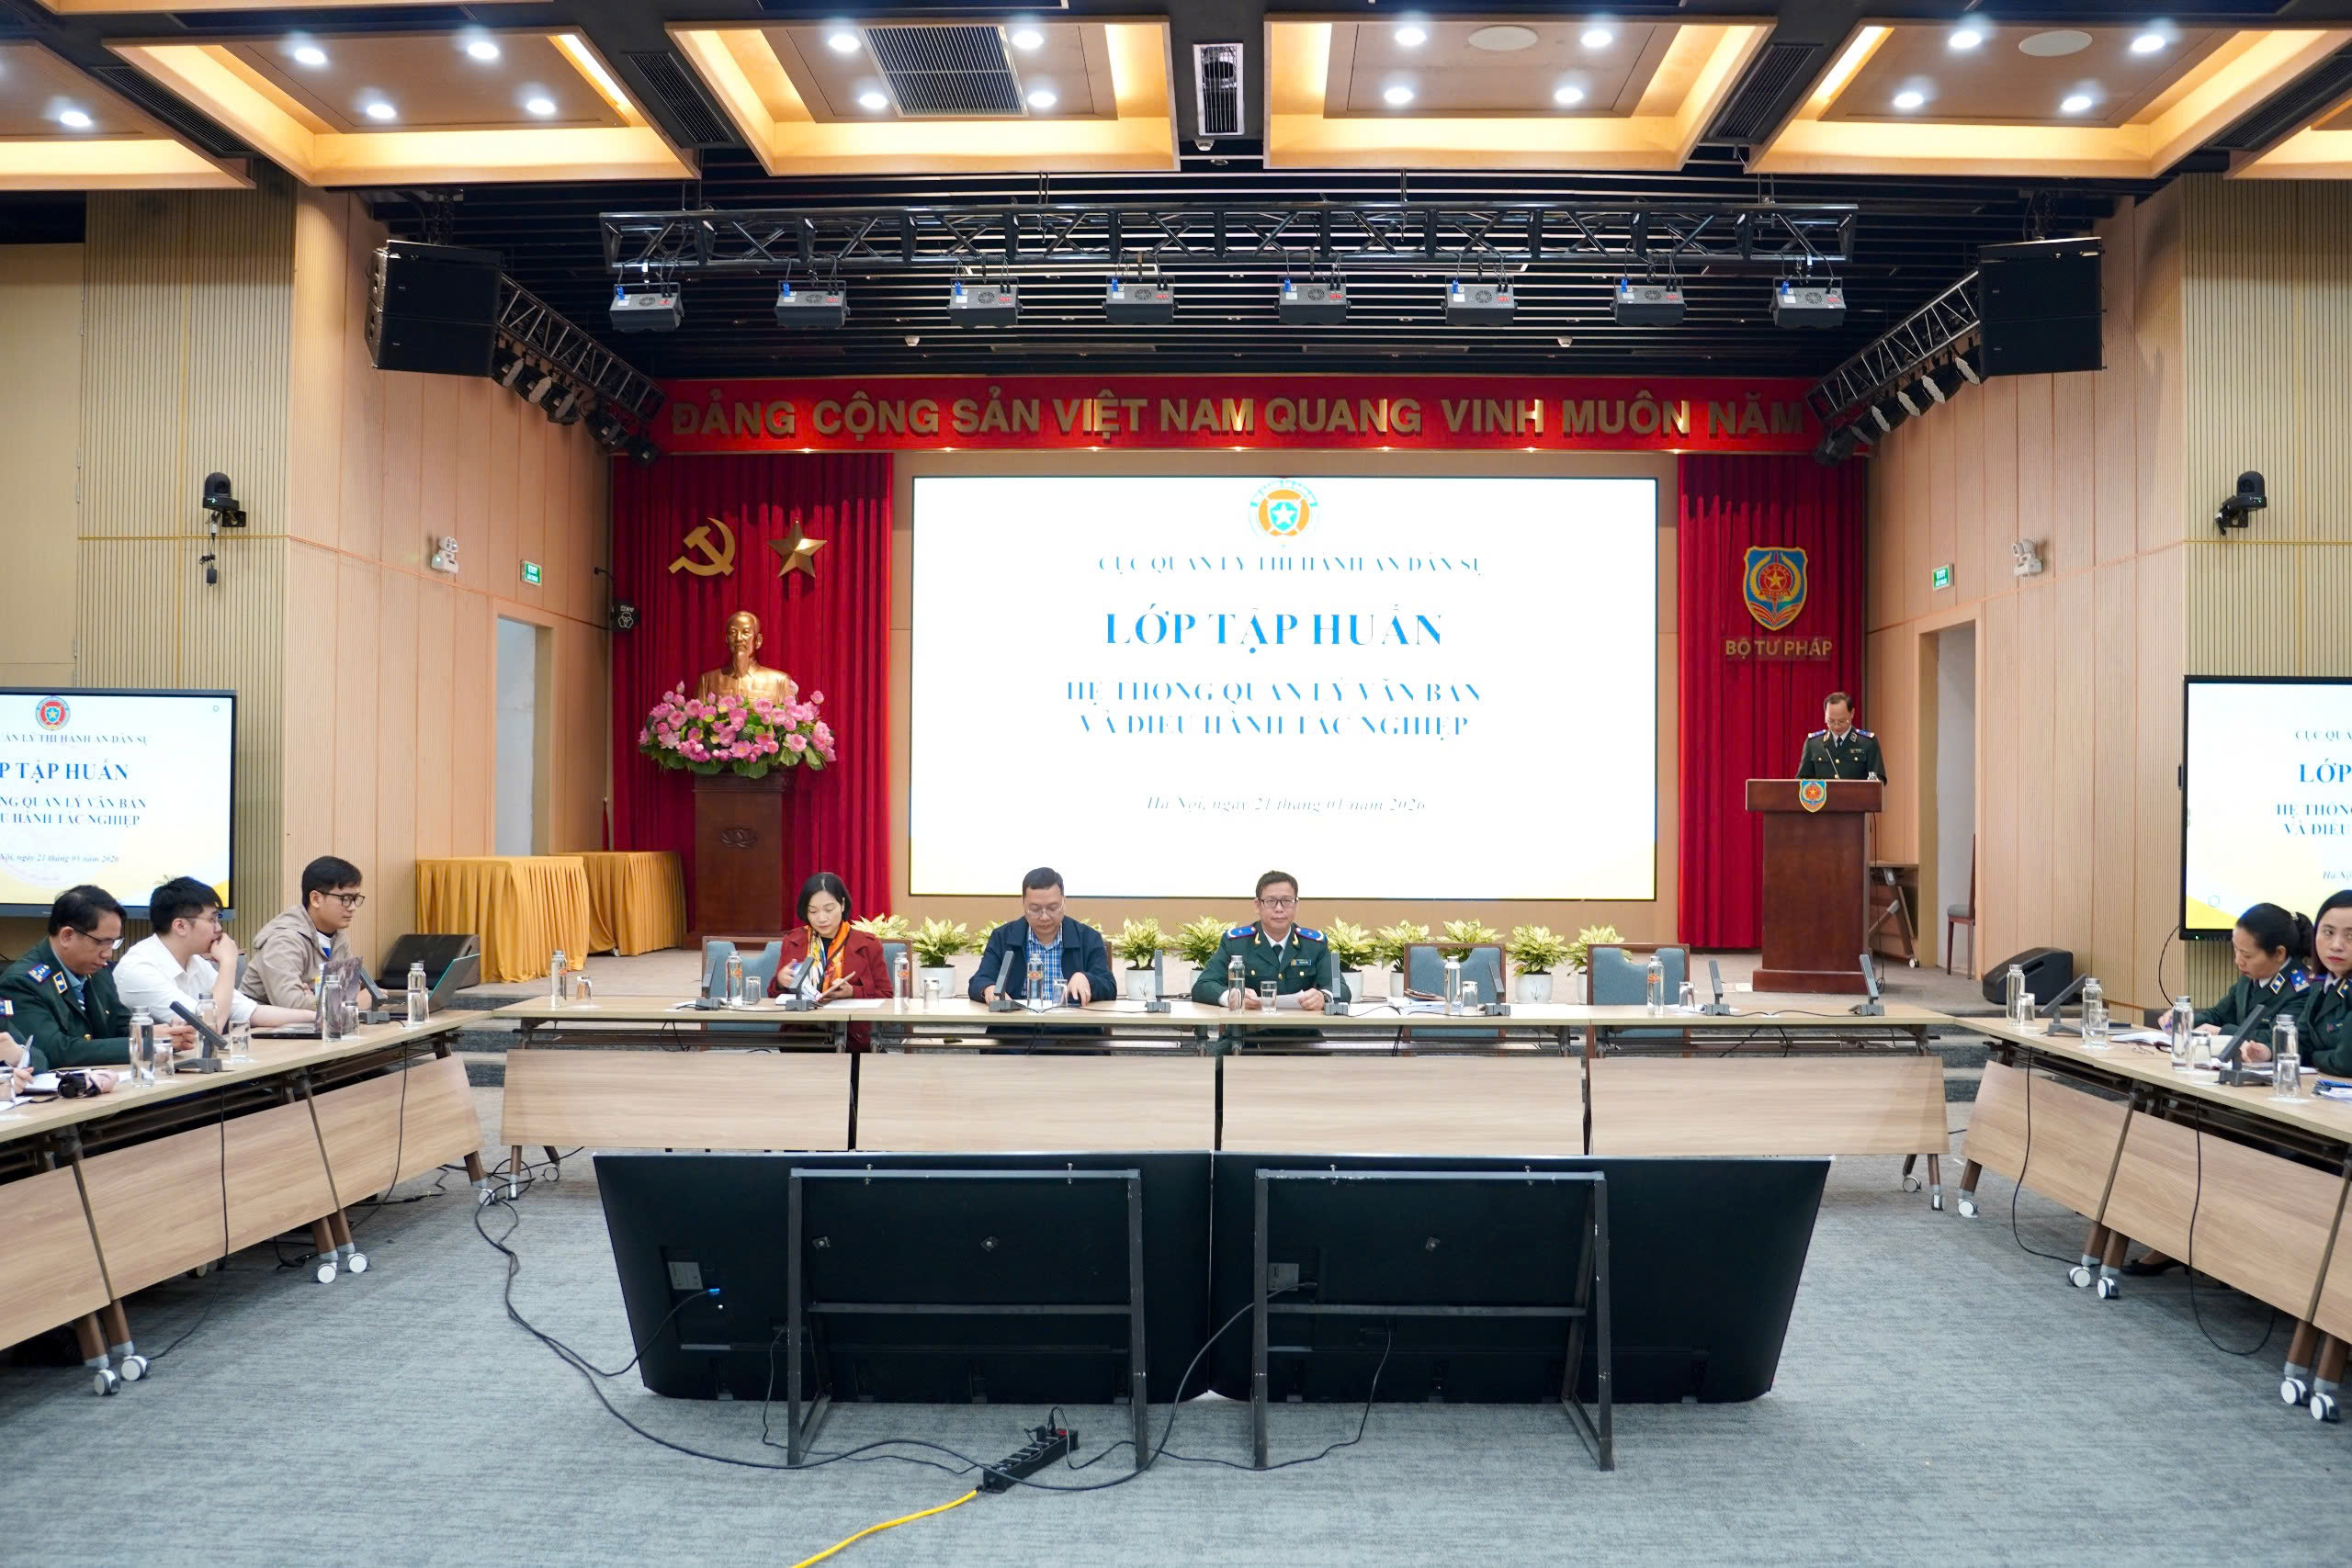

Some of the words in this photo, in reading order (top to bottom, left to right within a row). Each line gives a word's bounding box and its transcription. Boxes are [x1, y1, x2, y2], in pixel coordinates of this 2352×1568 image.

[672, 389, 796, 434] ĐẢNG
[812, 391, 939, 441] CỘNG
[952, 386, 1040, 433] SẢN
[1053, 389, 1148, 439] VIỆT
[1161, 398, 1254, 433] NAM
[1265, 398, 1422, 433] QUANG
[1442, 398, 1544, 433] VINH
[1564, 389, 1690, 434] MUÔN
[1709, 391, 1803, 434] NĂM
[1105, 604, 1196, 645] LỚP
[1208, 606, 1299, 654] TẬP
[1313, 604, 1442, 646] HUẤN
[1726, 637, 1751, 660] BỘ
[1755, 638, 1781, 655] TƯ
[1784, 637, 1833, 656] PHÁP
[16, 760, 59, 784] TẬP
[66, 759, 129, 780] HUẤN
[2300, 758, 2352, 783] LỚP
